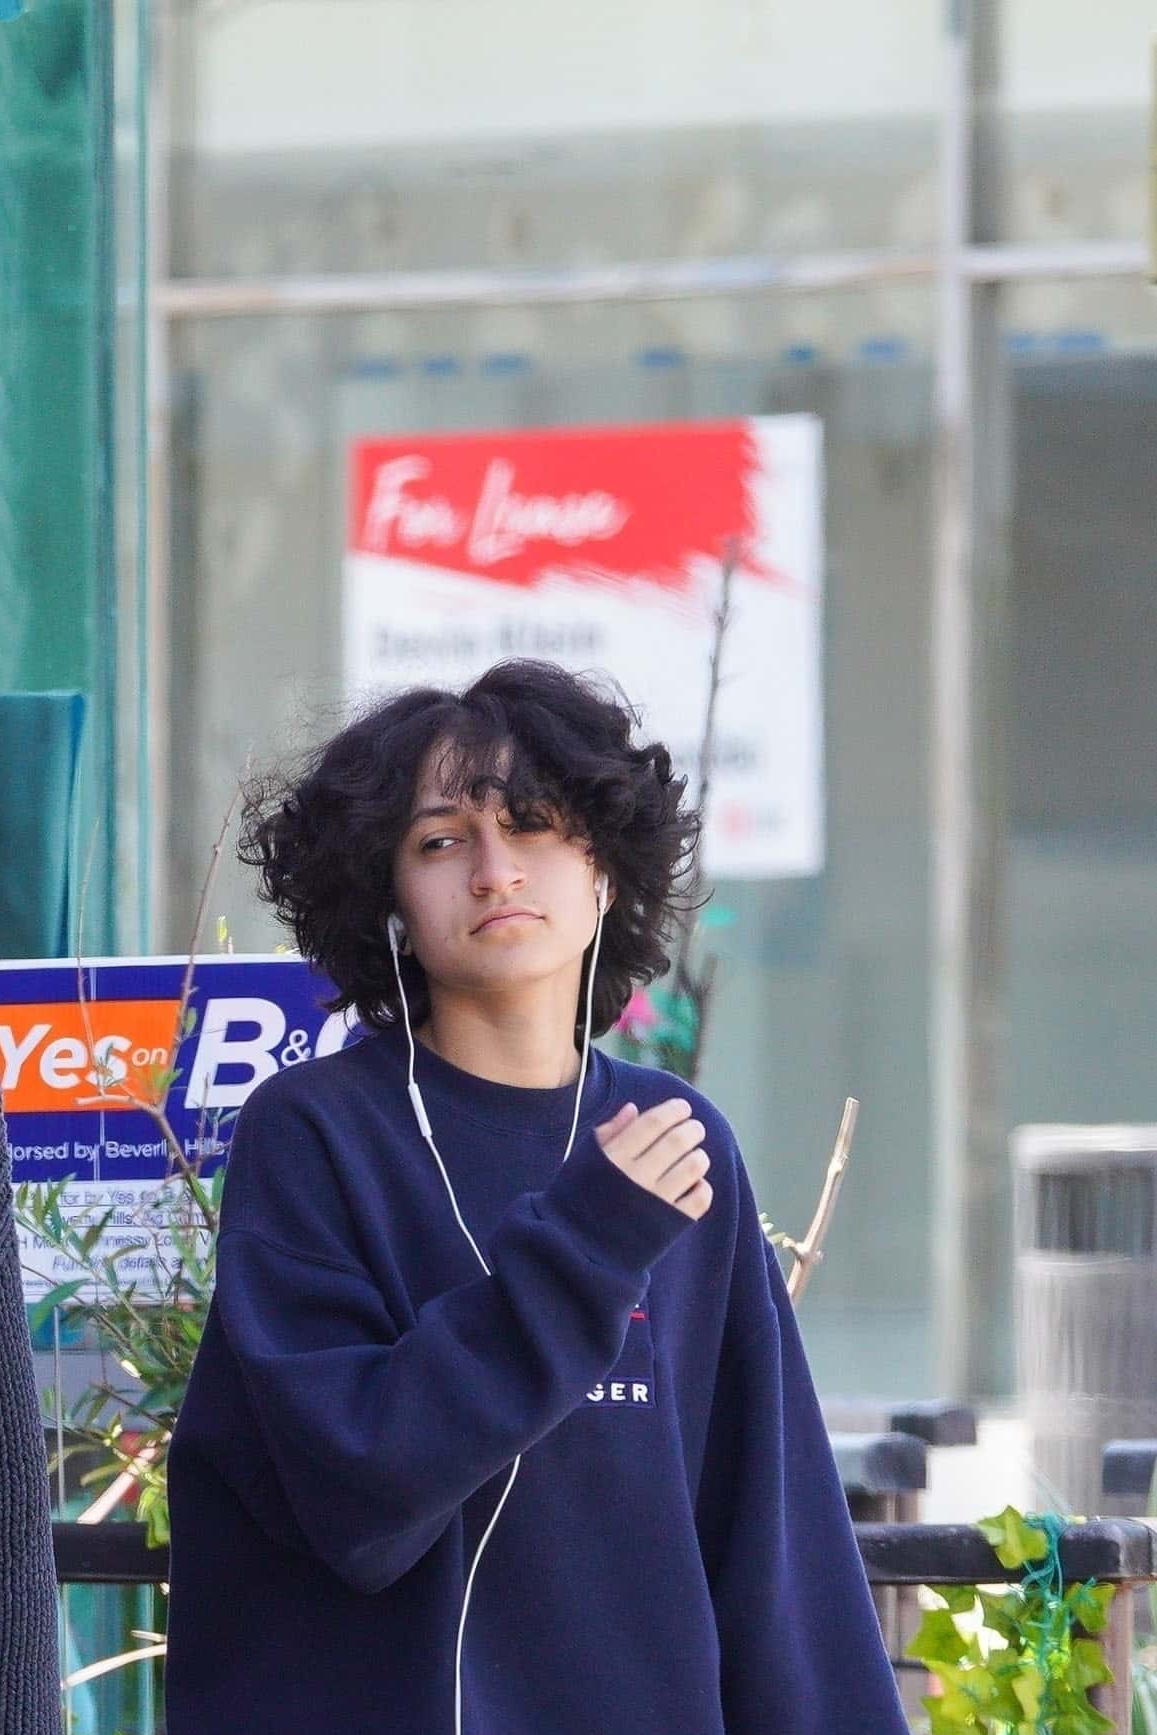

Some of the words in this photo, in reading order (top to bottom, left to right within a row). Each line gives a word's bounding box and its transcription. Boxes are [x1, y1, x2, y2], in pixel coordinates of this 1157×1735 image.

[131, 1046, 168, 1067] on
[9, 1142, 70, 1162] orsed
[74, 1141, 96, 1161] by
[104, 1138, 175, 1159] Beverl
